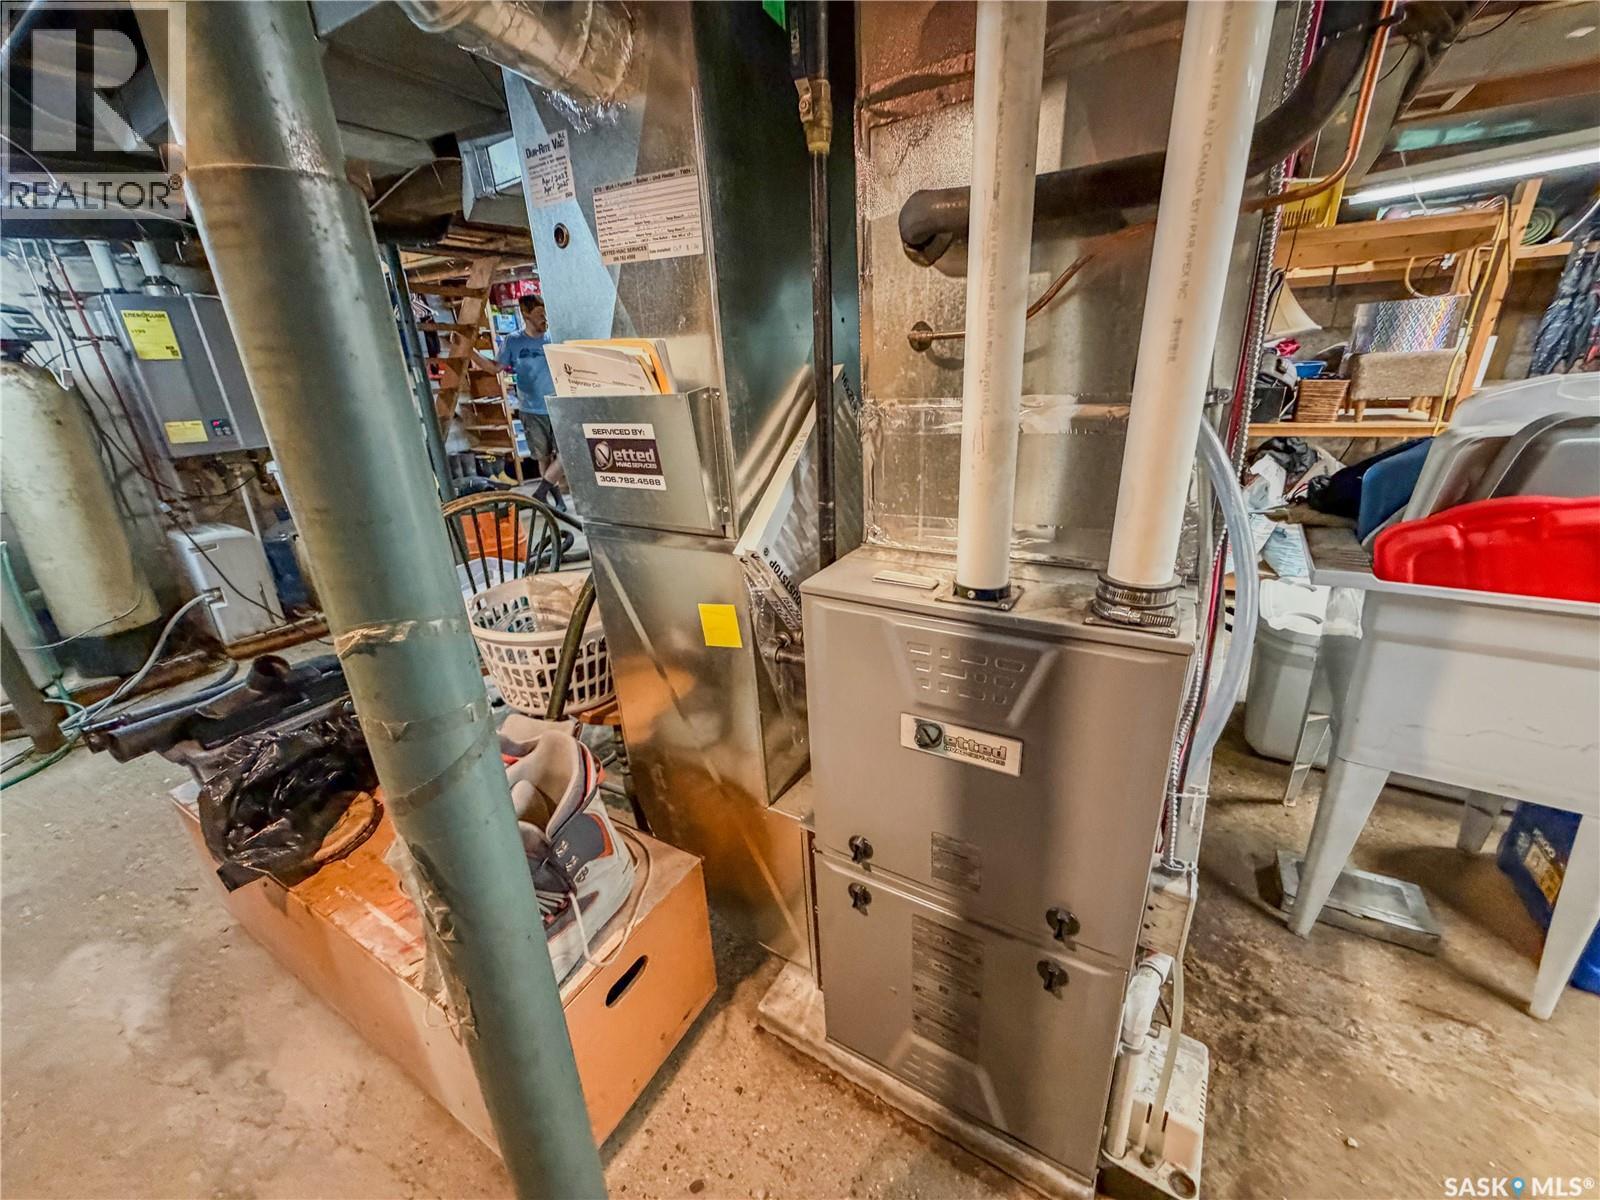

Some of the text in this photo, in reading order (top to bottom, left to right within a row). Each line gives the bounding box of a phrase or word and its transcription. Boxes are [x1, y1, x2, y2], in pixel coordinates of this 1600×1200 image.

[1191, 140, 1214, 194] CANADA
[591, 428, 646, 436] SERVICED BY:
